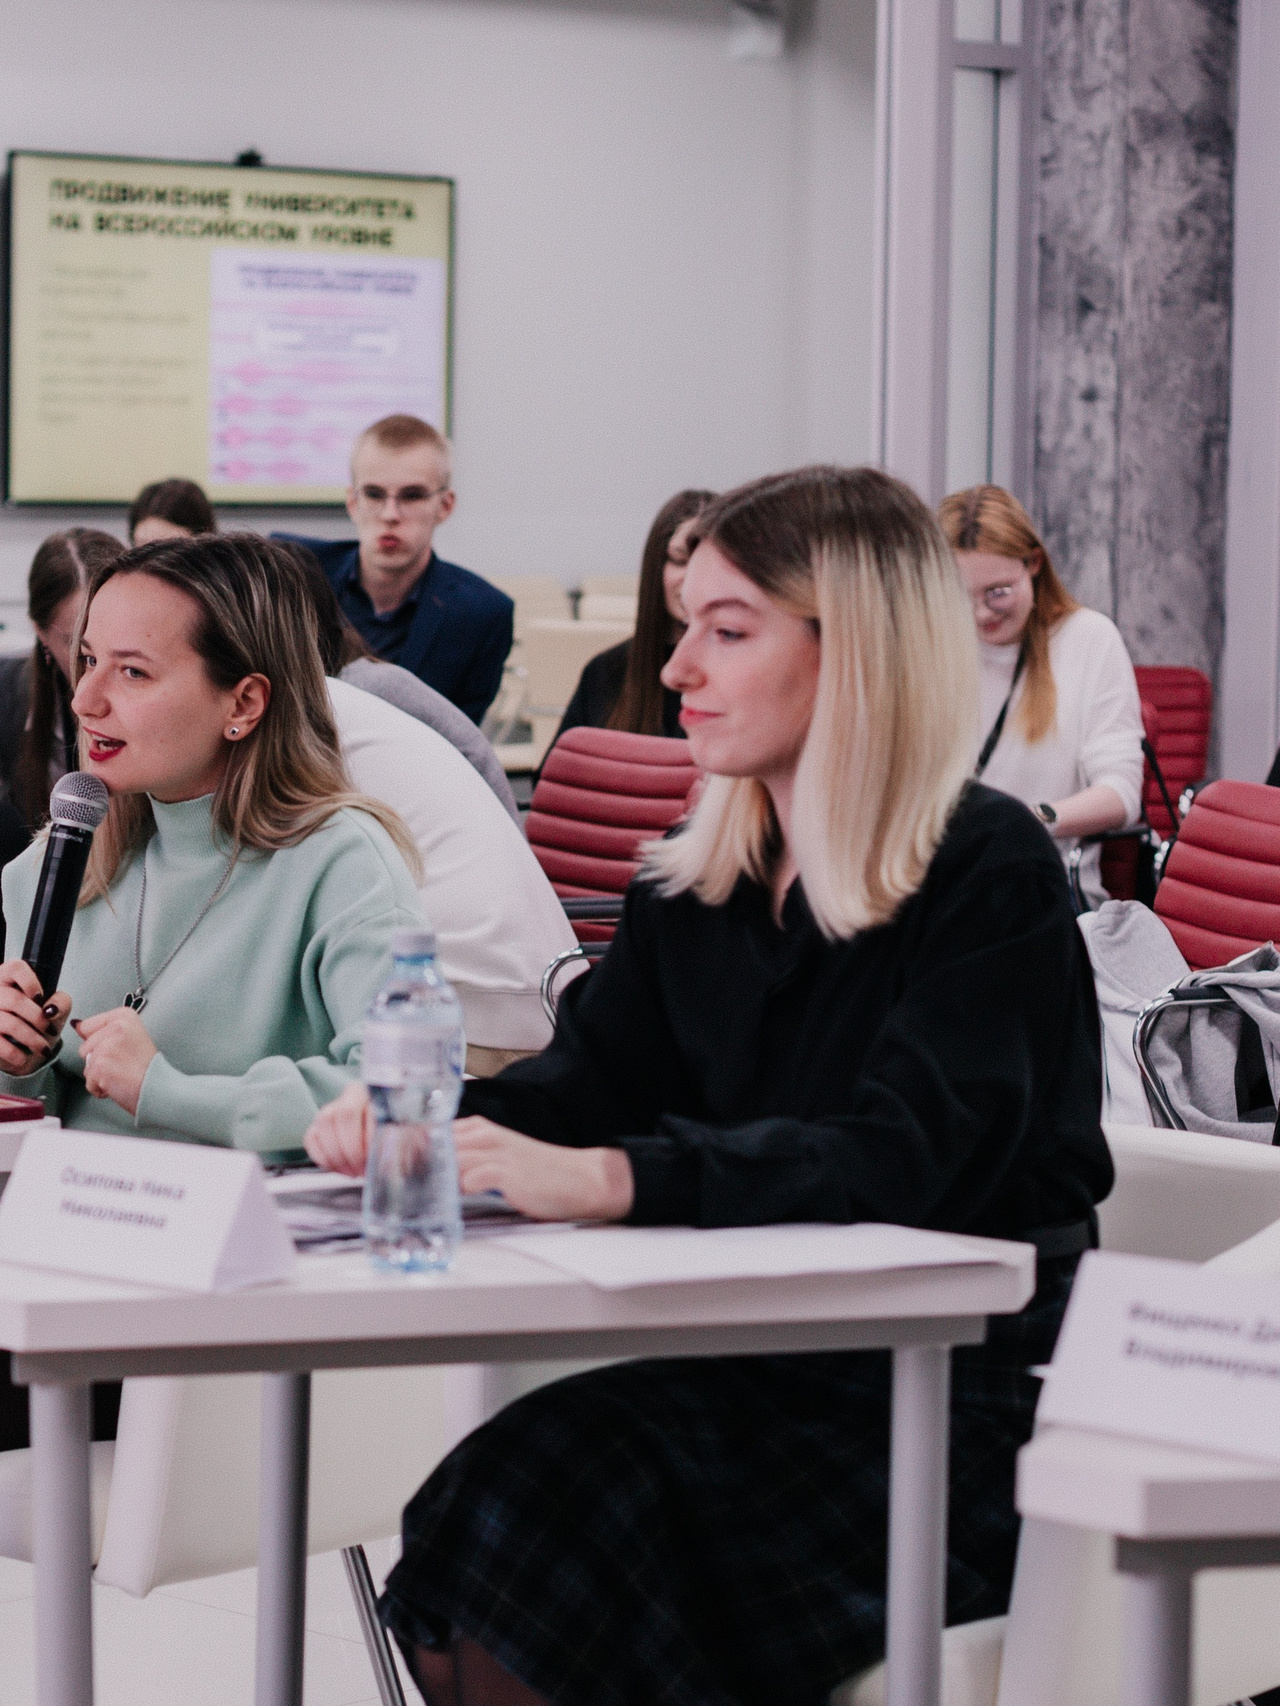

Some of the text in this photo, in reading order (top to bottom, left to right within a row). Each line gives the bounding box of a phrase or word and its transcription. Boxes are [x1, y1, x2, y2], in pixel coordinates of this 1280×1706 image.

[49, 178, 417, 221] ПРОДВИЖЕНИЕ УНИВЕРСИТЕТА
[49, 211, 82, 232] НА
[311, 225, 395, 248] УРОВНЕ
